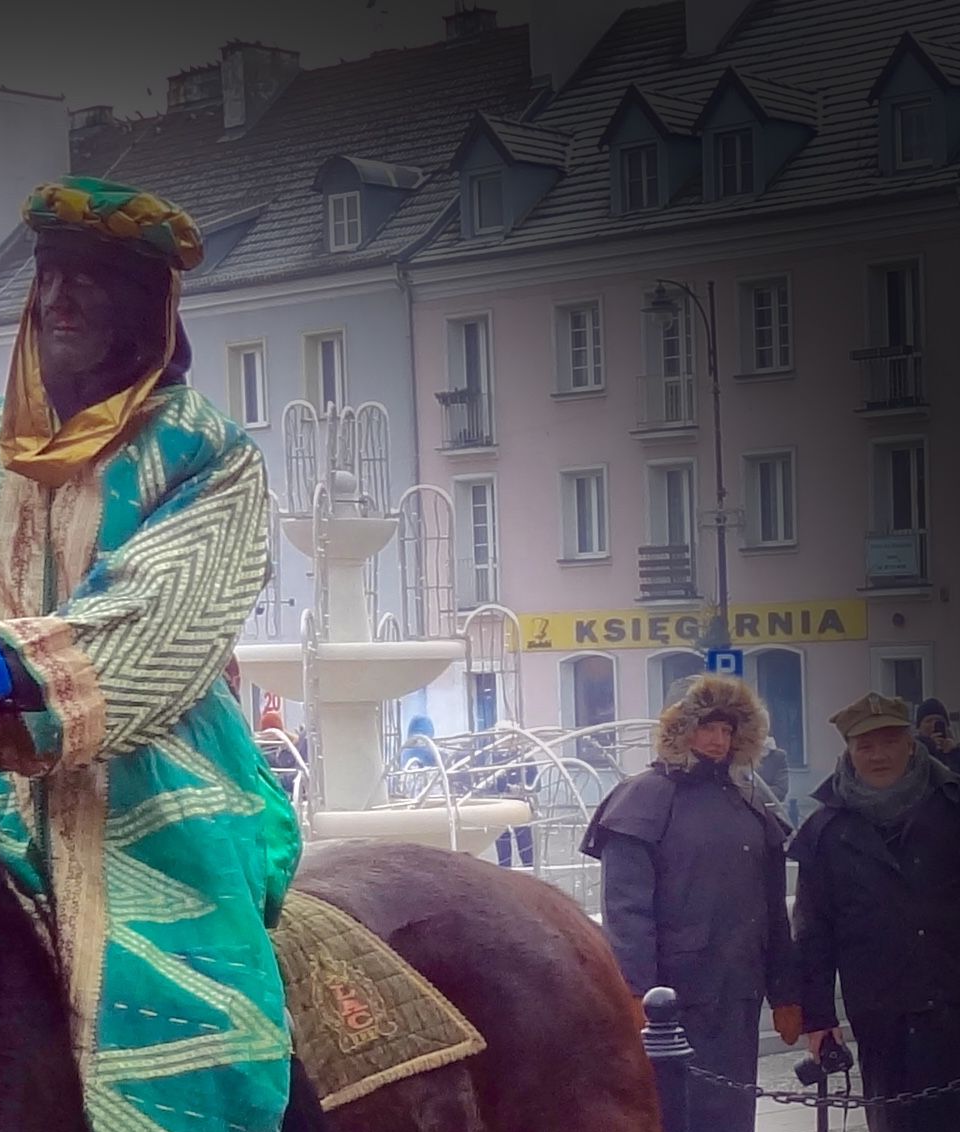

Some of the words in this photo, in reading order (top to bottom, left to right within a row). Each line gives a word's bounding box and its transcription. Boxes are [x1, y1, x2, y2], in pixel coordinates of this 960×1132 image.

[575, 609, 846, 645] KSIĘGRNIA
[716, 653, 736, 673] P
[263, 692, 281, 714] 20
